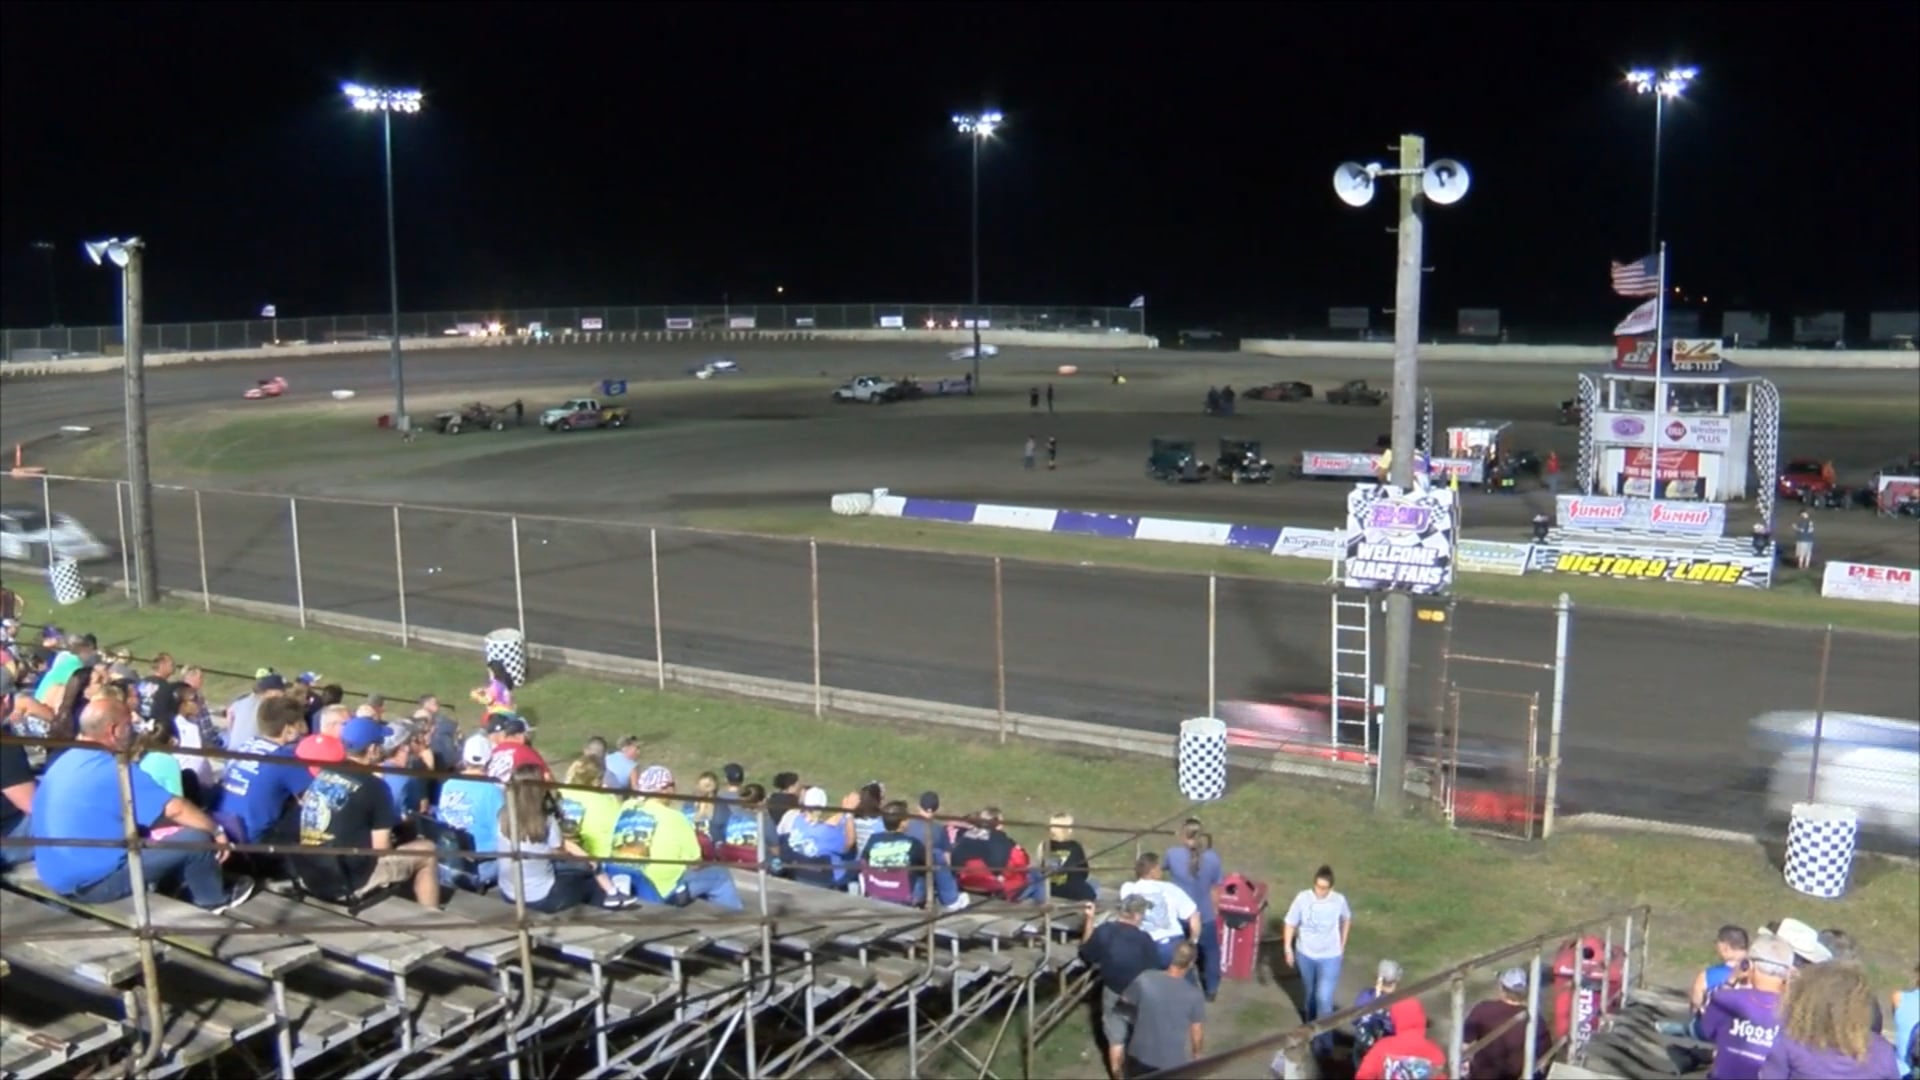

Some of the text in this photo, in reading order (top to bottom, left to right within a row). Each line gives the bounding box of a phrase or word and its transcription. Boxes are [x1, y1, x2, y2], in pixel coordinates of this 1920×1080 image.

[1357, 543, 1438, 565] WELCOME
[1351, 560, 1442, 585] RACE FANS
[1556, 553, 1744, 583] VICTORY LANE
[1848, 565, 1912, 582] PEM
